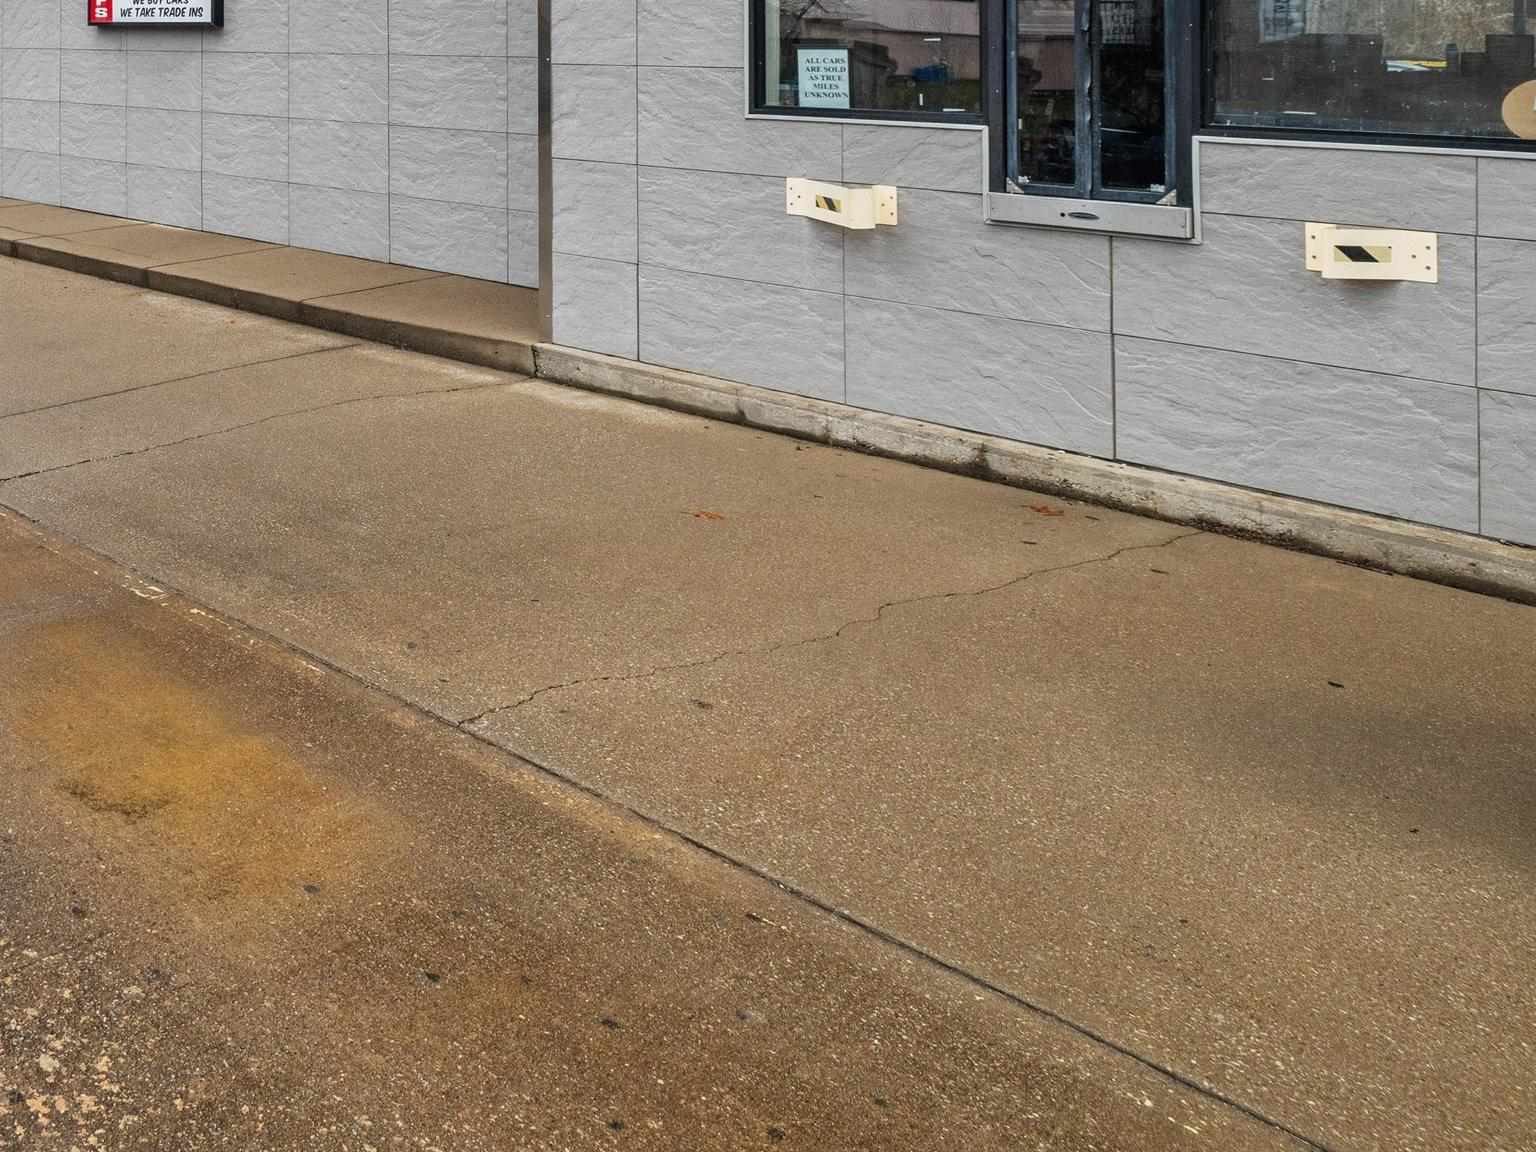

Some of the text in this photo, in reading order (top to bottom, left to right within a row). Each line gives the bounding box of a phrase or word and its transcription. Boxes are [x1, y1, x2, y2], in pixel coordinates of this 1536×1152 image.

[120, 6, 204, 18] WE TAKE TRADE INS
